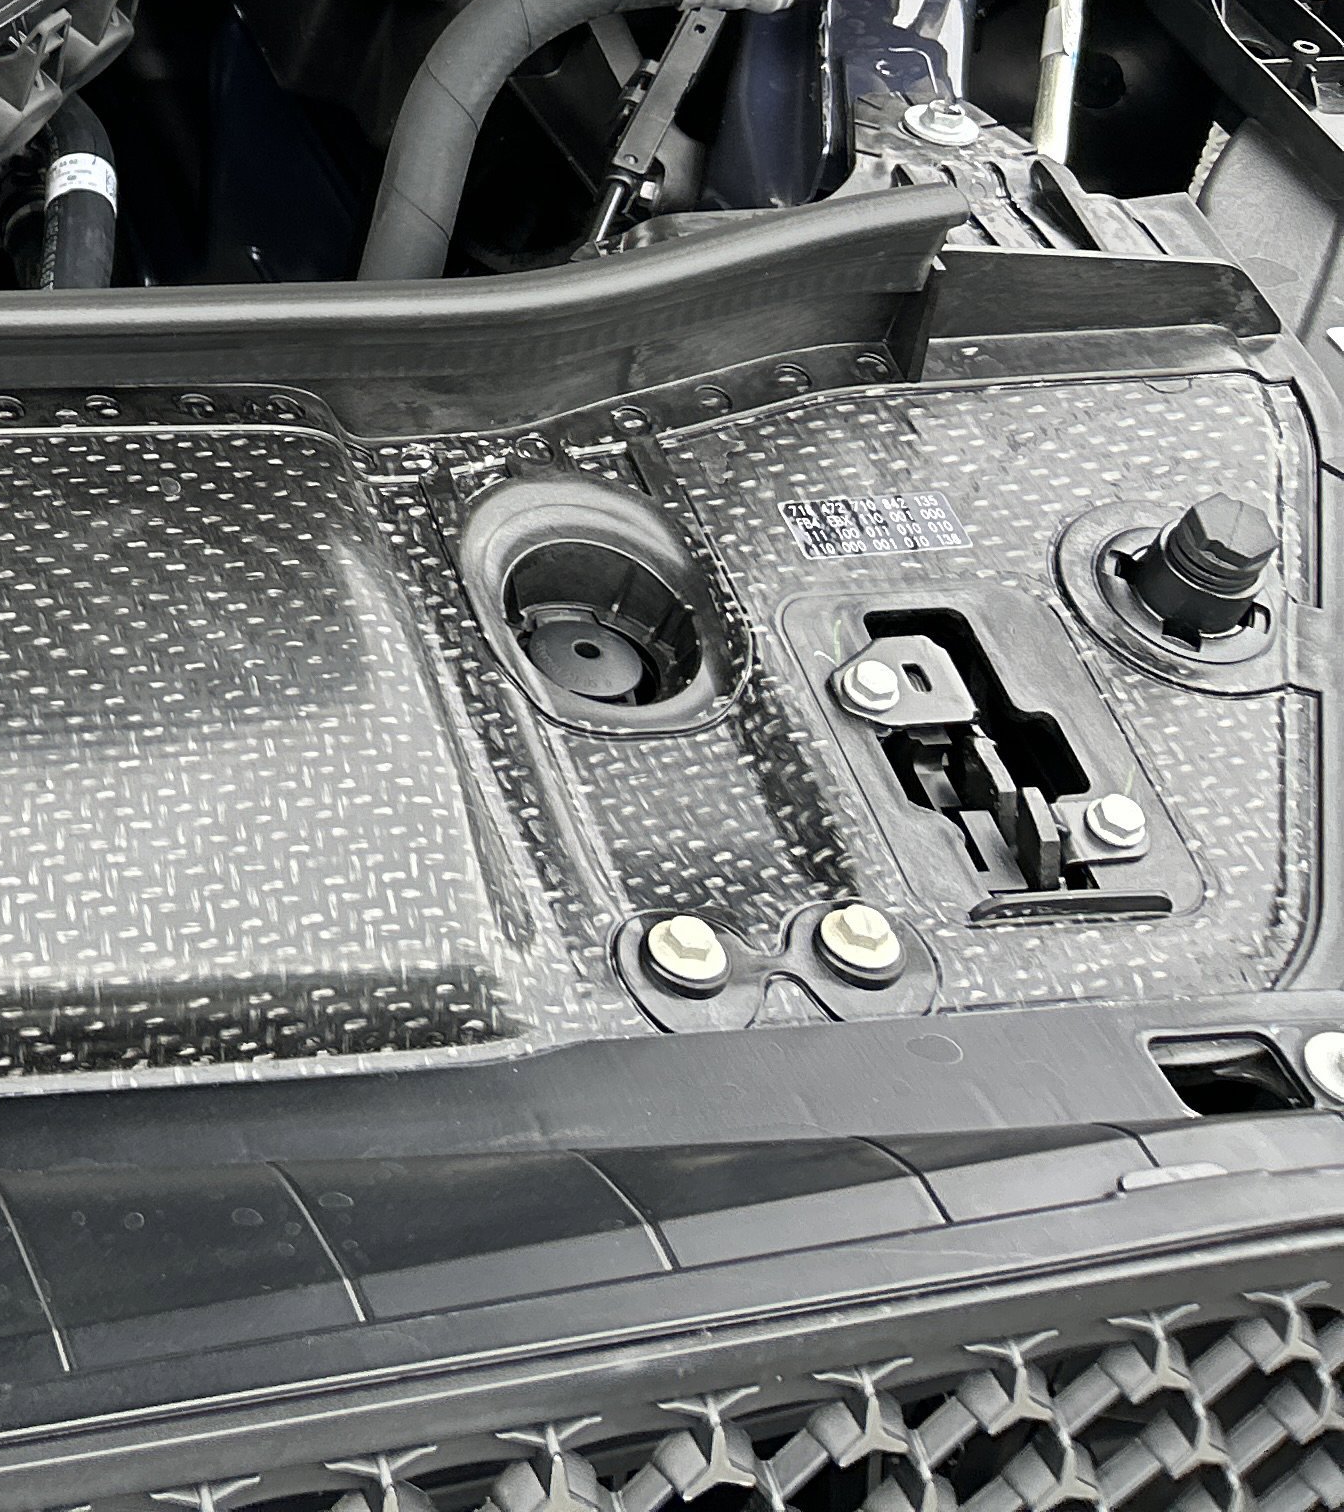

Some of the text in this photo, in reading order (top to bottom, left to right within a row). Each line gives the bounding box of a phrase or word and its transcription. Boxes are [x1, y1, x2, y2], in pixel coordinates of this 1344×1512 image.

[913, 494, 939, 506] 135
[888, 509, 915, 522] 001
[919, 507, 947, 519] 000
[864, 524, 891, 537] 011
[896, 522, 923, 535] 010
[927, 519, 954, 532] 010
[812, 542, 837, 555] 110
[841, 540, 869, 552] 000
[872, 537, 898, 550] 001
[903, 535, 931, 548] 010
